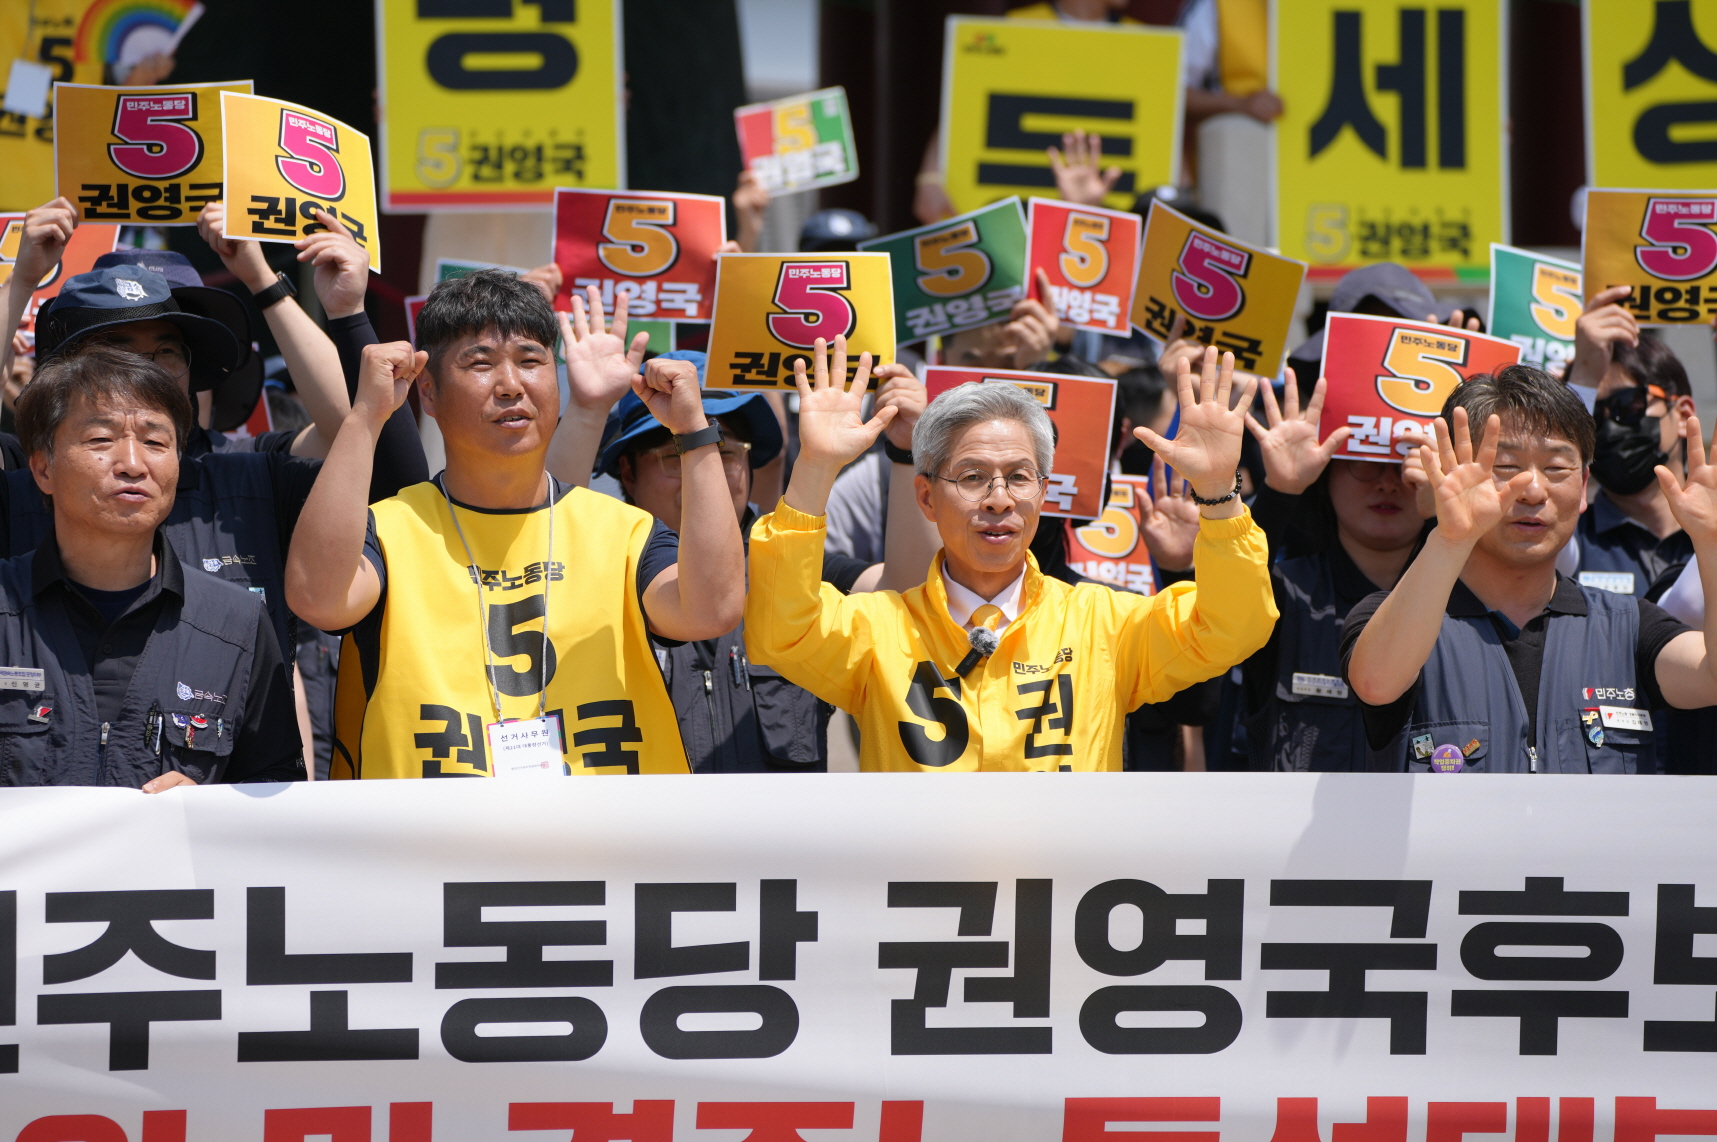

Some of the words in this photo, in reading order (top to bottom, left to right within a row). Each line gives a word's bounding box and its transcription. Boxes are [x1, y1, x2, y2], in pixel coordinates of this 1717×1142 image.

[126, 99, 186, 111] 민주노동당
[288, 116, 332, 139] 민주노동당
[772, 102, 819, 155] 5
[1307, 8, 1467, 171] 세
[107, 92, 204, 182] 5
[275, 108, 346, 203] 5
[415, 126, 463, 189] 5
[467, 143, 586, 184] 권영국
[597, 198, 680, 278] 5
[1305, 202, 1351, 264] 5
[1359, 220, 1473, 263] 권영국
[1634, 197, 1717, 283] 5
[1655, 203, 1713, 214] 민주노동당
[788, 268, 841, 279] 민주노동당
[914, 219, 994, 298] 5
[1058, 211, 1111, 288] 5
[1171, 228, 1253, 323] 5
[571, 277, 702, 317] 권영국
[765, 260, 857, 351] 5
[1529, 261, 1584, 341] 5
[1375, 326, 1471, 419] 5
[1400, 334, 1458, 352] 민주노동당
[222, 554, 257, 566] 금속노조
[1074, 483, 1135, 559] 5
[467, 561, 565, 591] 민주노동당
[485, 594, 557, 697] 5
[898, 660, 969, 767] 5
[1015, 674, 1074, 772] 권
[1595, 688, 1635, 700] 민주노총
[414, 700, 643, 778] 권국
[0, 878, 818, 1074] 주노동당
